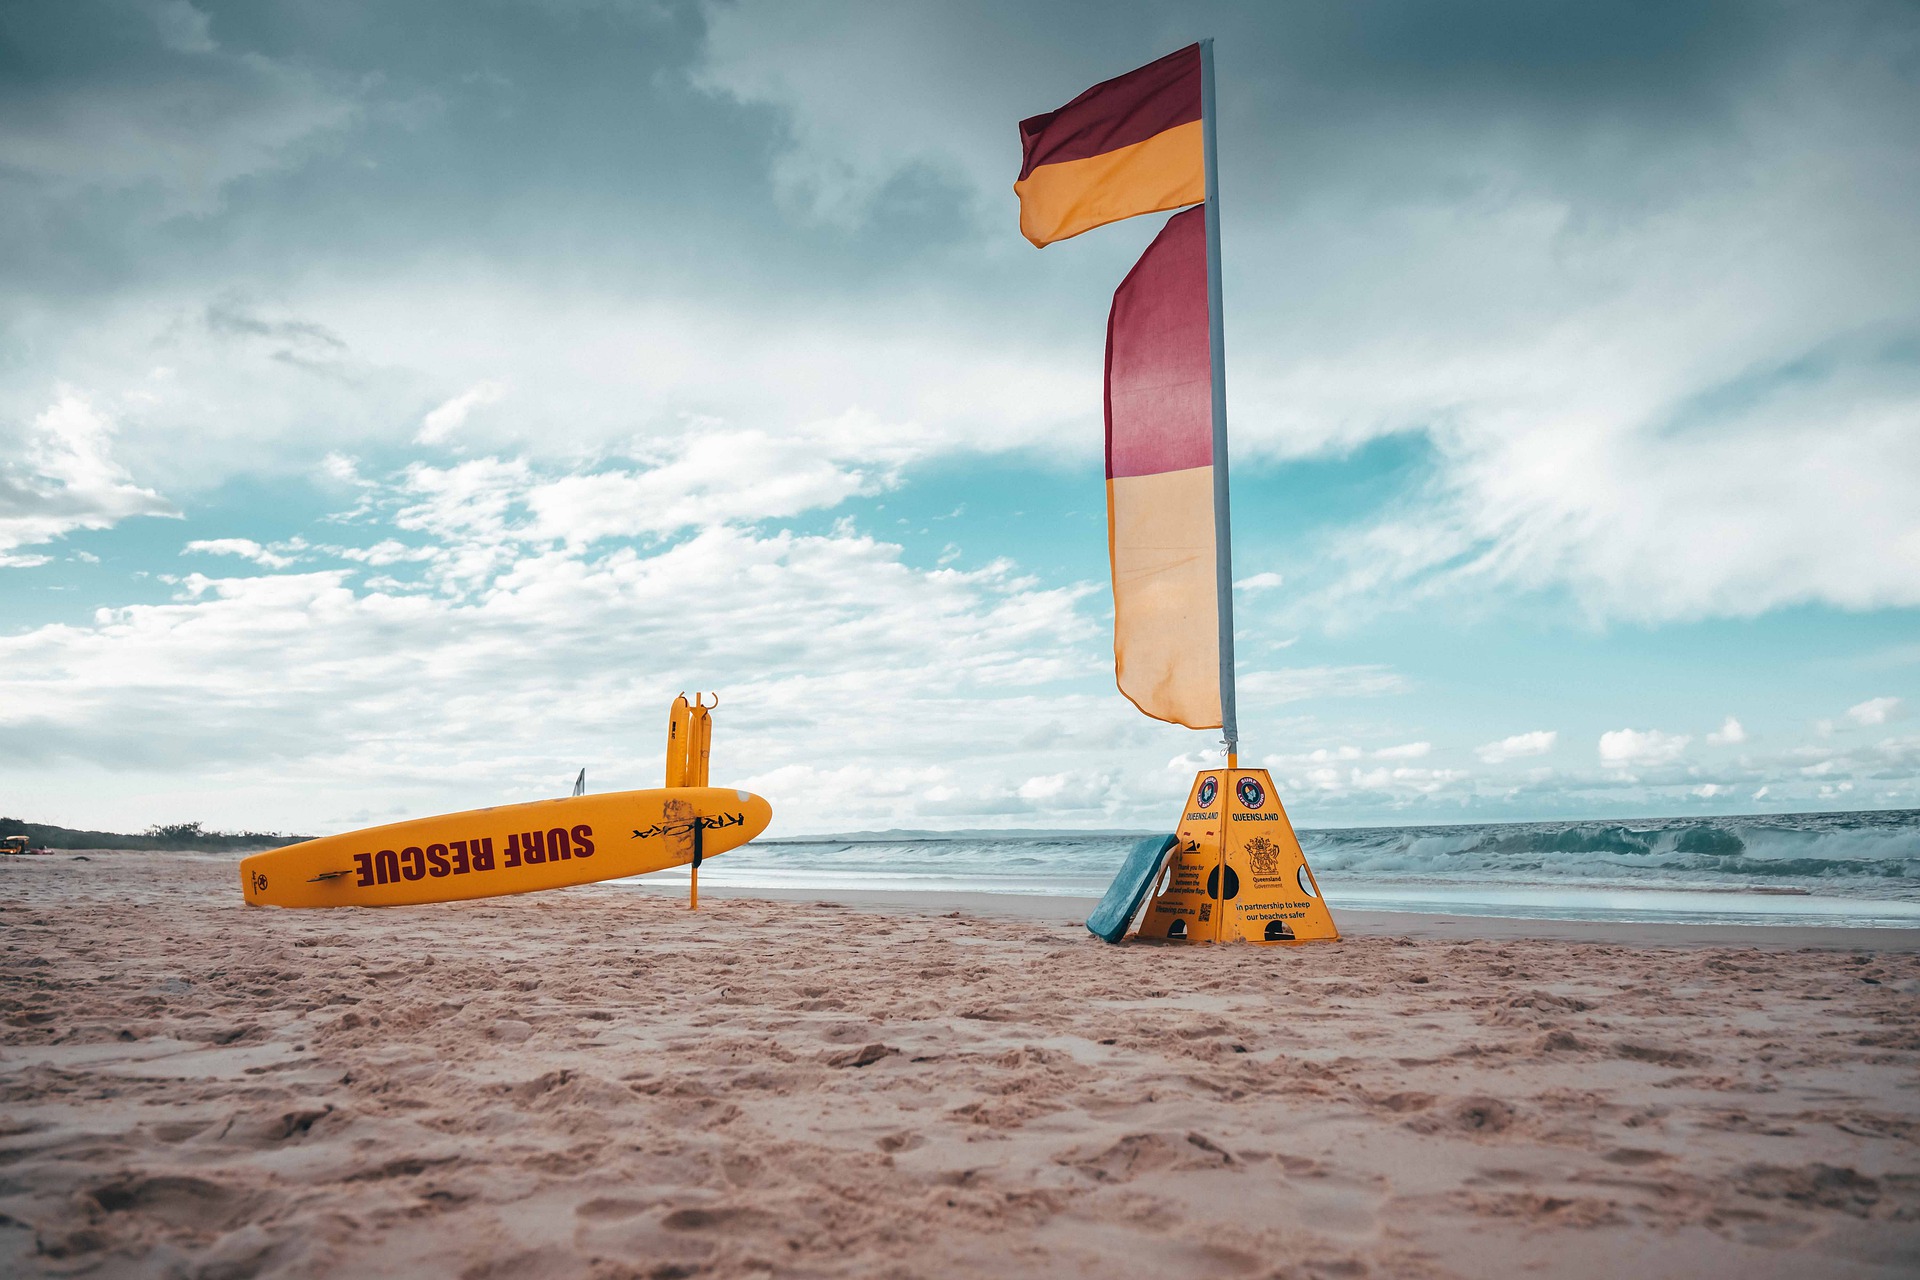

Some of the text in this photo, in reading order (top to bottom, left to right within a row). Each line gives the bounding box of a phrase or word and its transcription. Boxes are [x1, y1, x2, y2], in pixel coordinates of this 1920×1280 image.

[1238, 793, 1265, 809] LIFE SAVING
[1186, 812, 1218, 821] QUEENSLAND
[1232, 813, 1279, 822] QUEENSLAND
[353, 824, 595, 887] SURF RESCUE
[1244, 902, 1284, 911] partnership
[1293, 901, 1310, 909] keep
[1259, 912, 1288, 920] beaches
